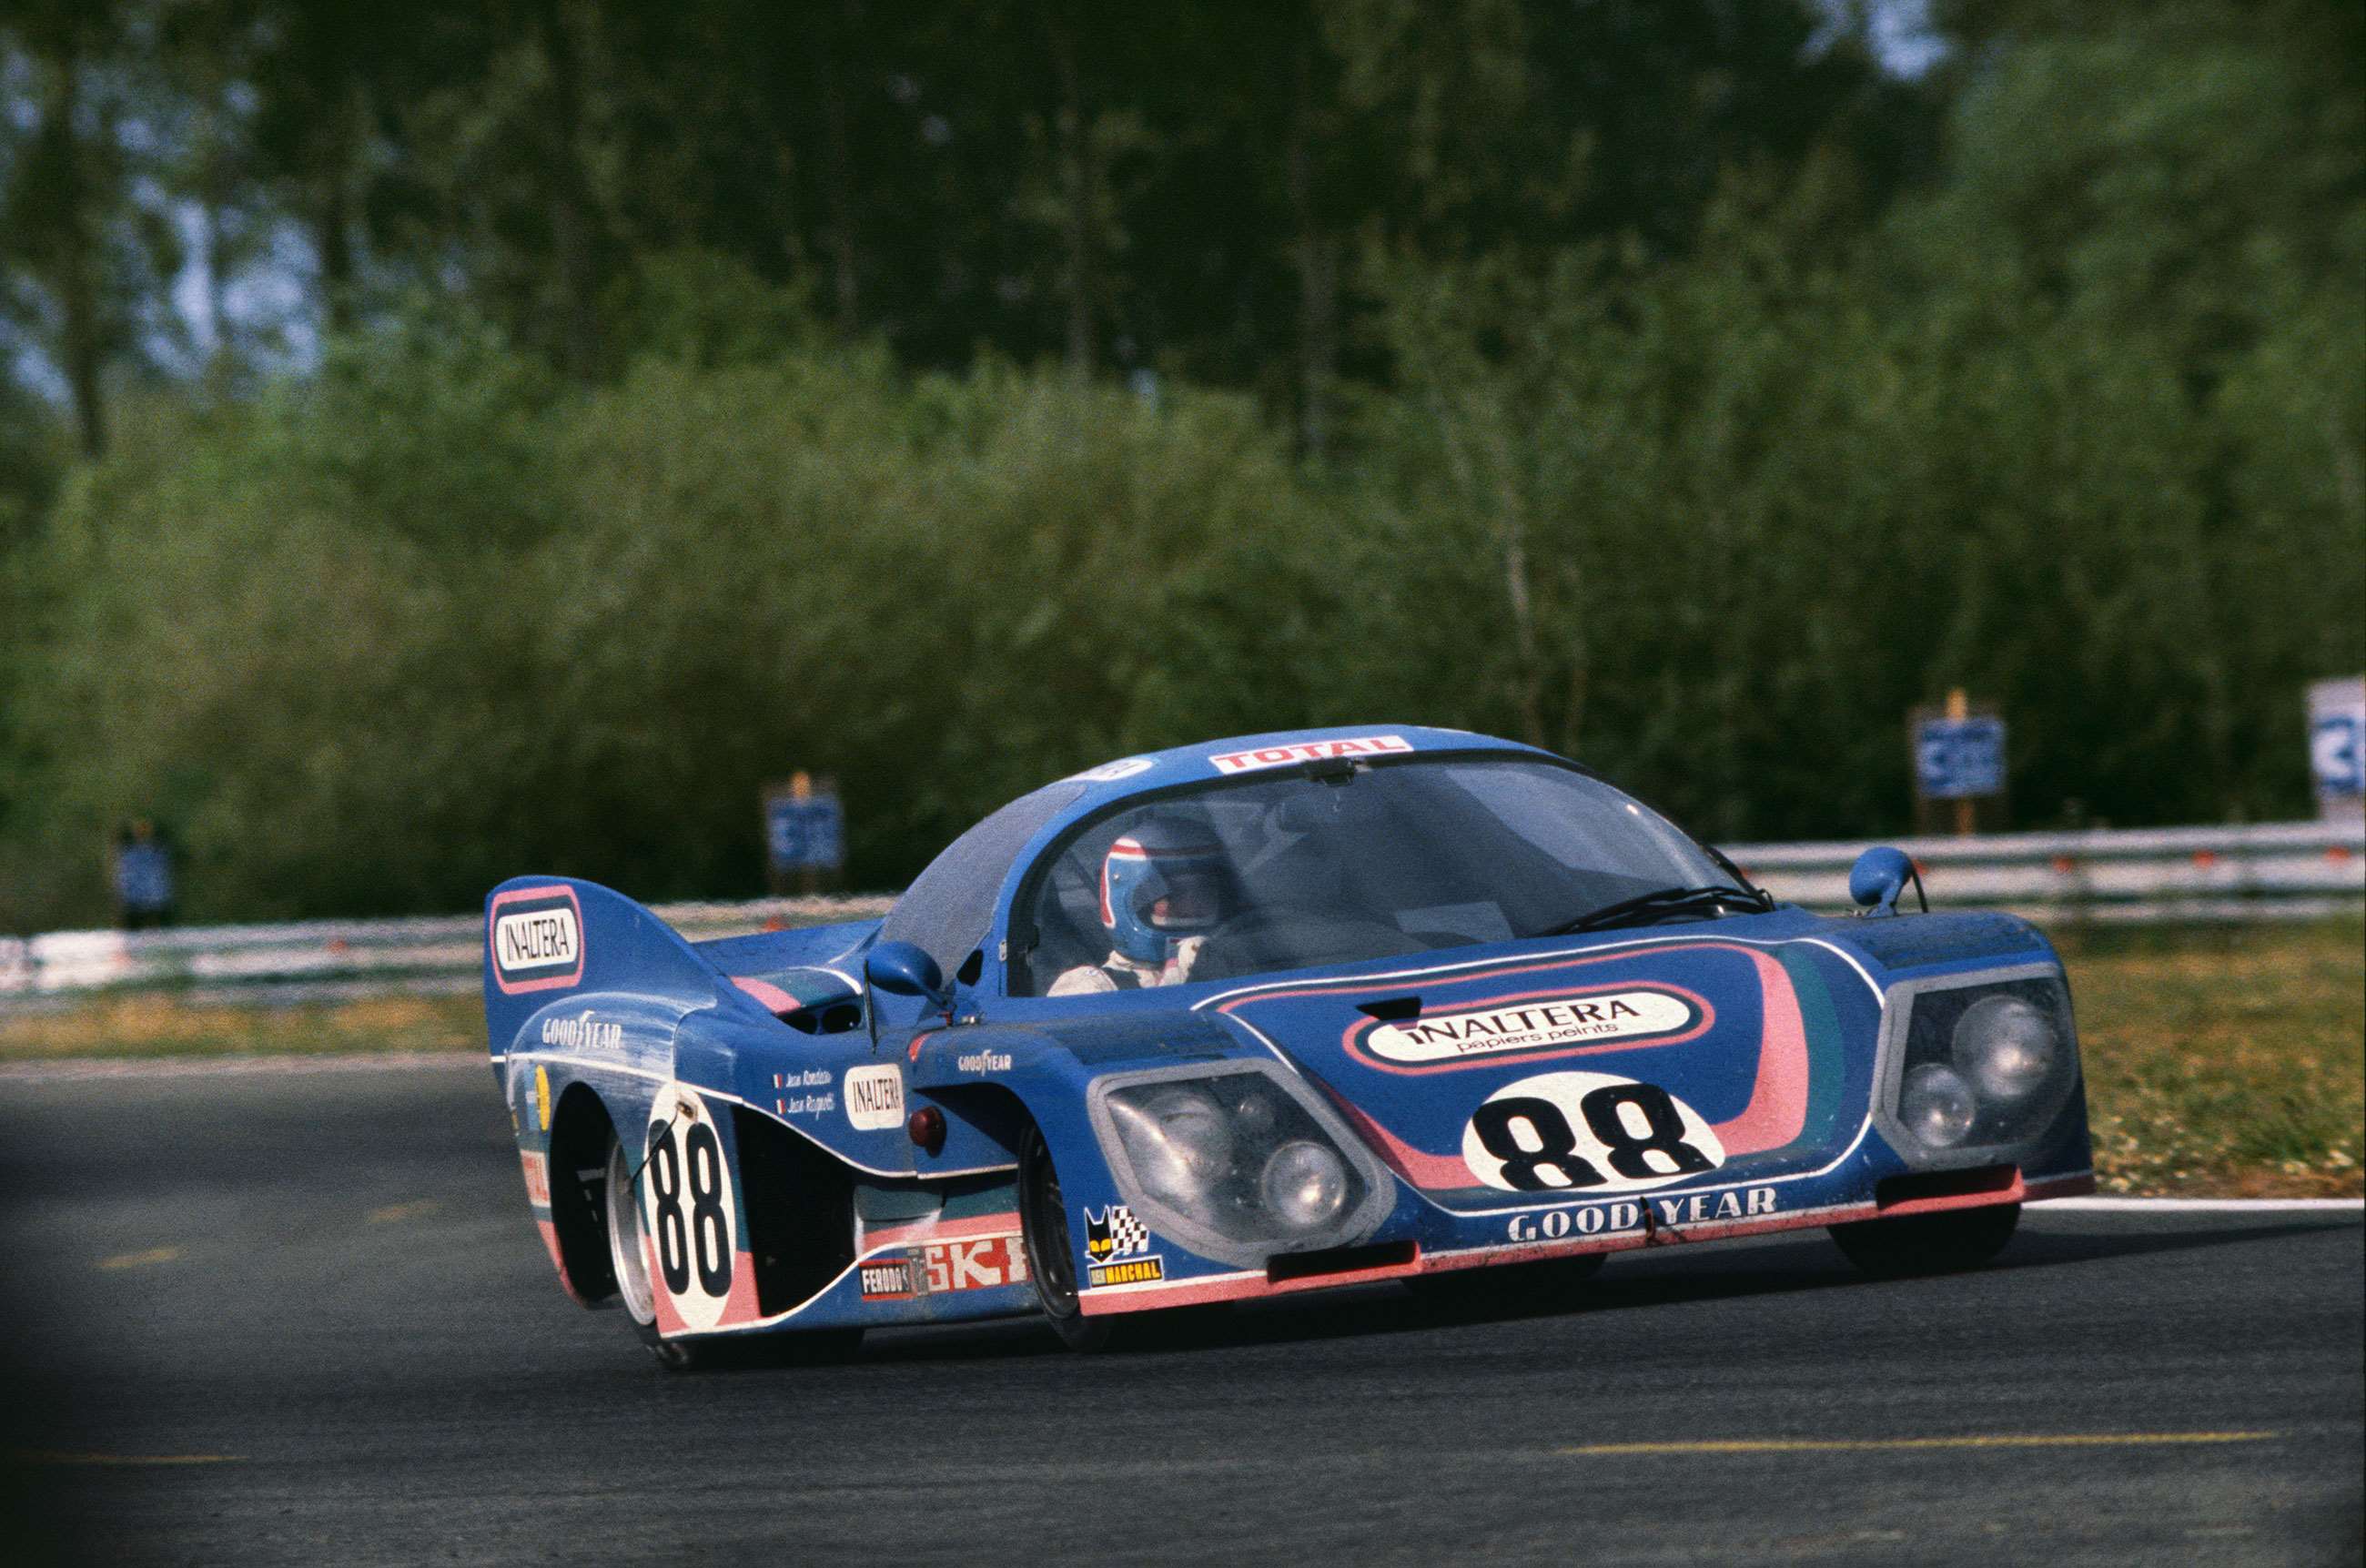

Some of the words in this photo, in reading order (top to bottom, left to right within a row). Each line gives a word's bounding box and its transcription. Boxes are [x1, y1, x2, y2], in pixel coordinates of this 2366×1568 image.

[1215, 738, 1406, 769] TOTAL
[506, 916, 570, 962] INALTERA
[1406, 999, 1641, 1045] INALTERA
[1456, 1034, 1543, 1053] papiers
[1547, 1022, 1620, 1042] peints
[852, 1077, 901, 1113] INALTERA
[1471, 1082, 1718, 1191] 88
[648, 1118, 733, 1298] 88
[862, 1267, 903, 1294] FERODO
[1106, 1260, 1161, 1284] MARCHAL
